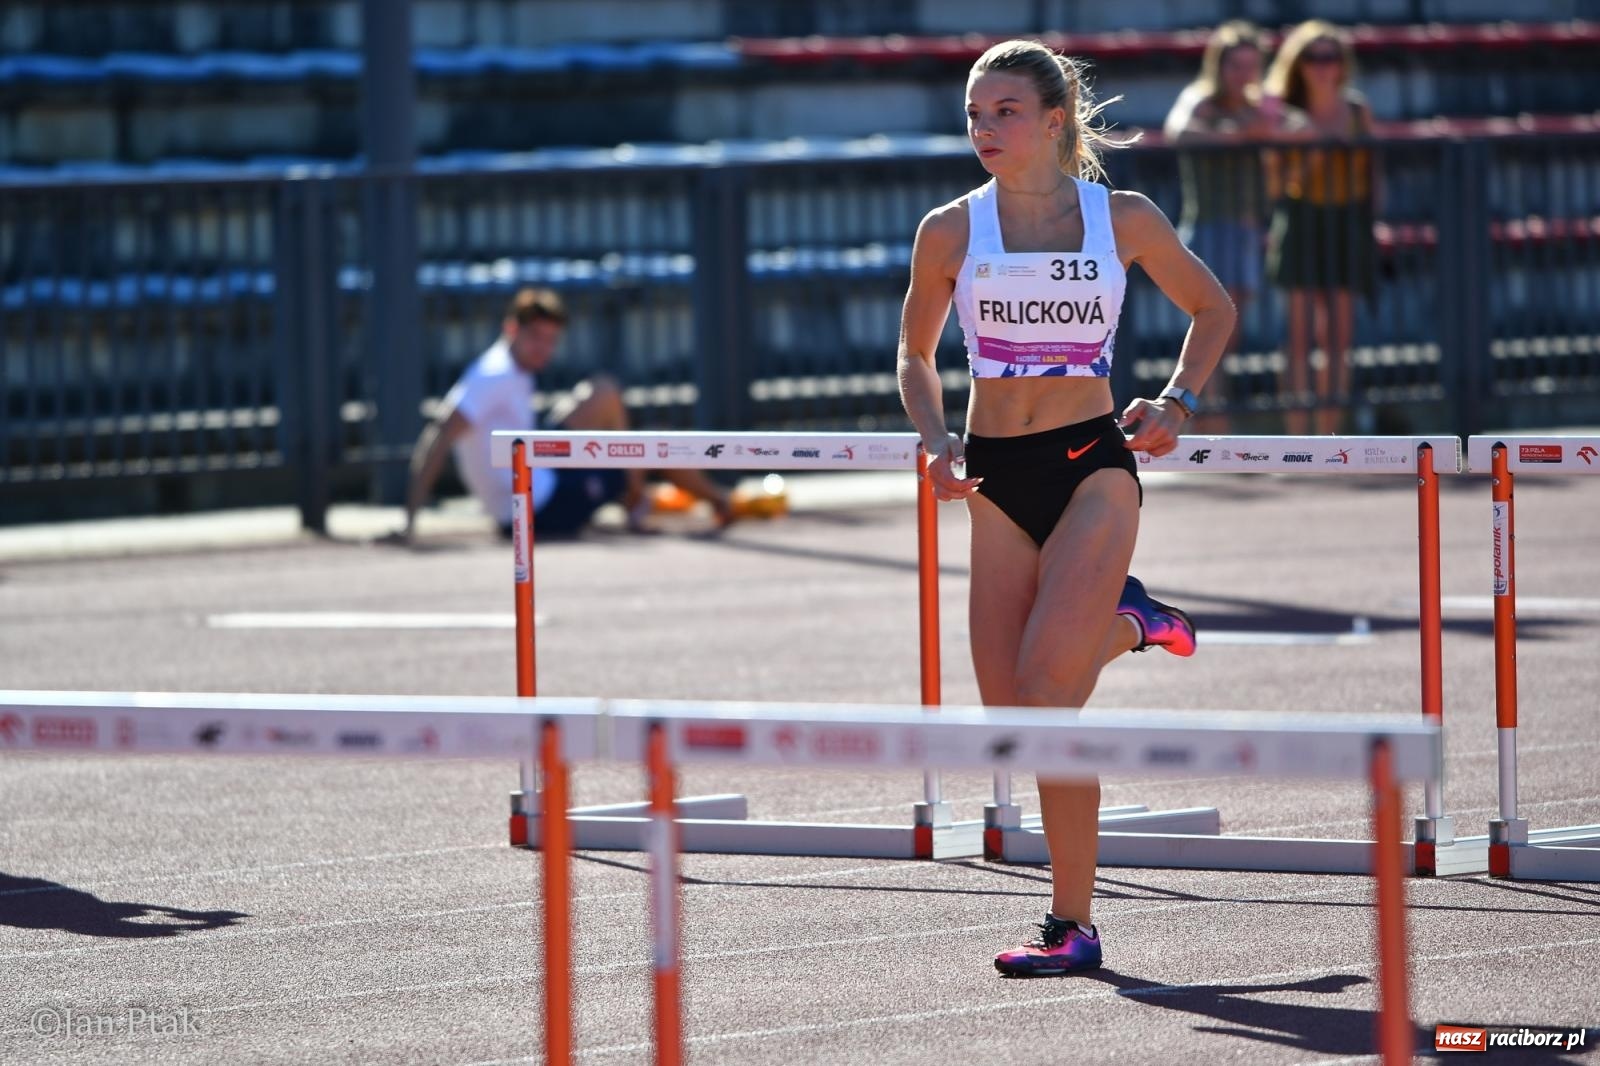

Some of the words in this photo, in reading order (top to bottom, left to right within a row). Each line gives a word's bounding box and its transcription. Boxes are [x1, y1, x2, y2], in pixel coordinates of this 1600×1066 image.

[1050, 259, 1098, 281] 313
[979, 296, 1105, 324] FRLICKOVÁ
[609, 446, 643, 456] ORLEN
[704, 444, 725, 458] 4F
[1189, 449, 1212, 464] 4F
[1282, 454, 1313, 463] 4MOVE
[1493, 526, 1504, 579] polanik
